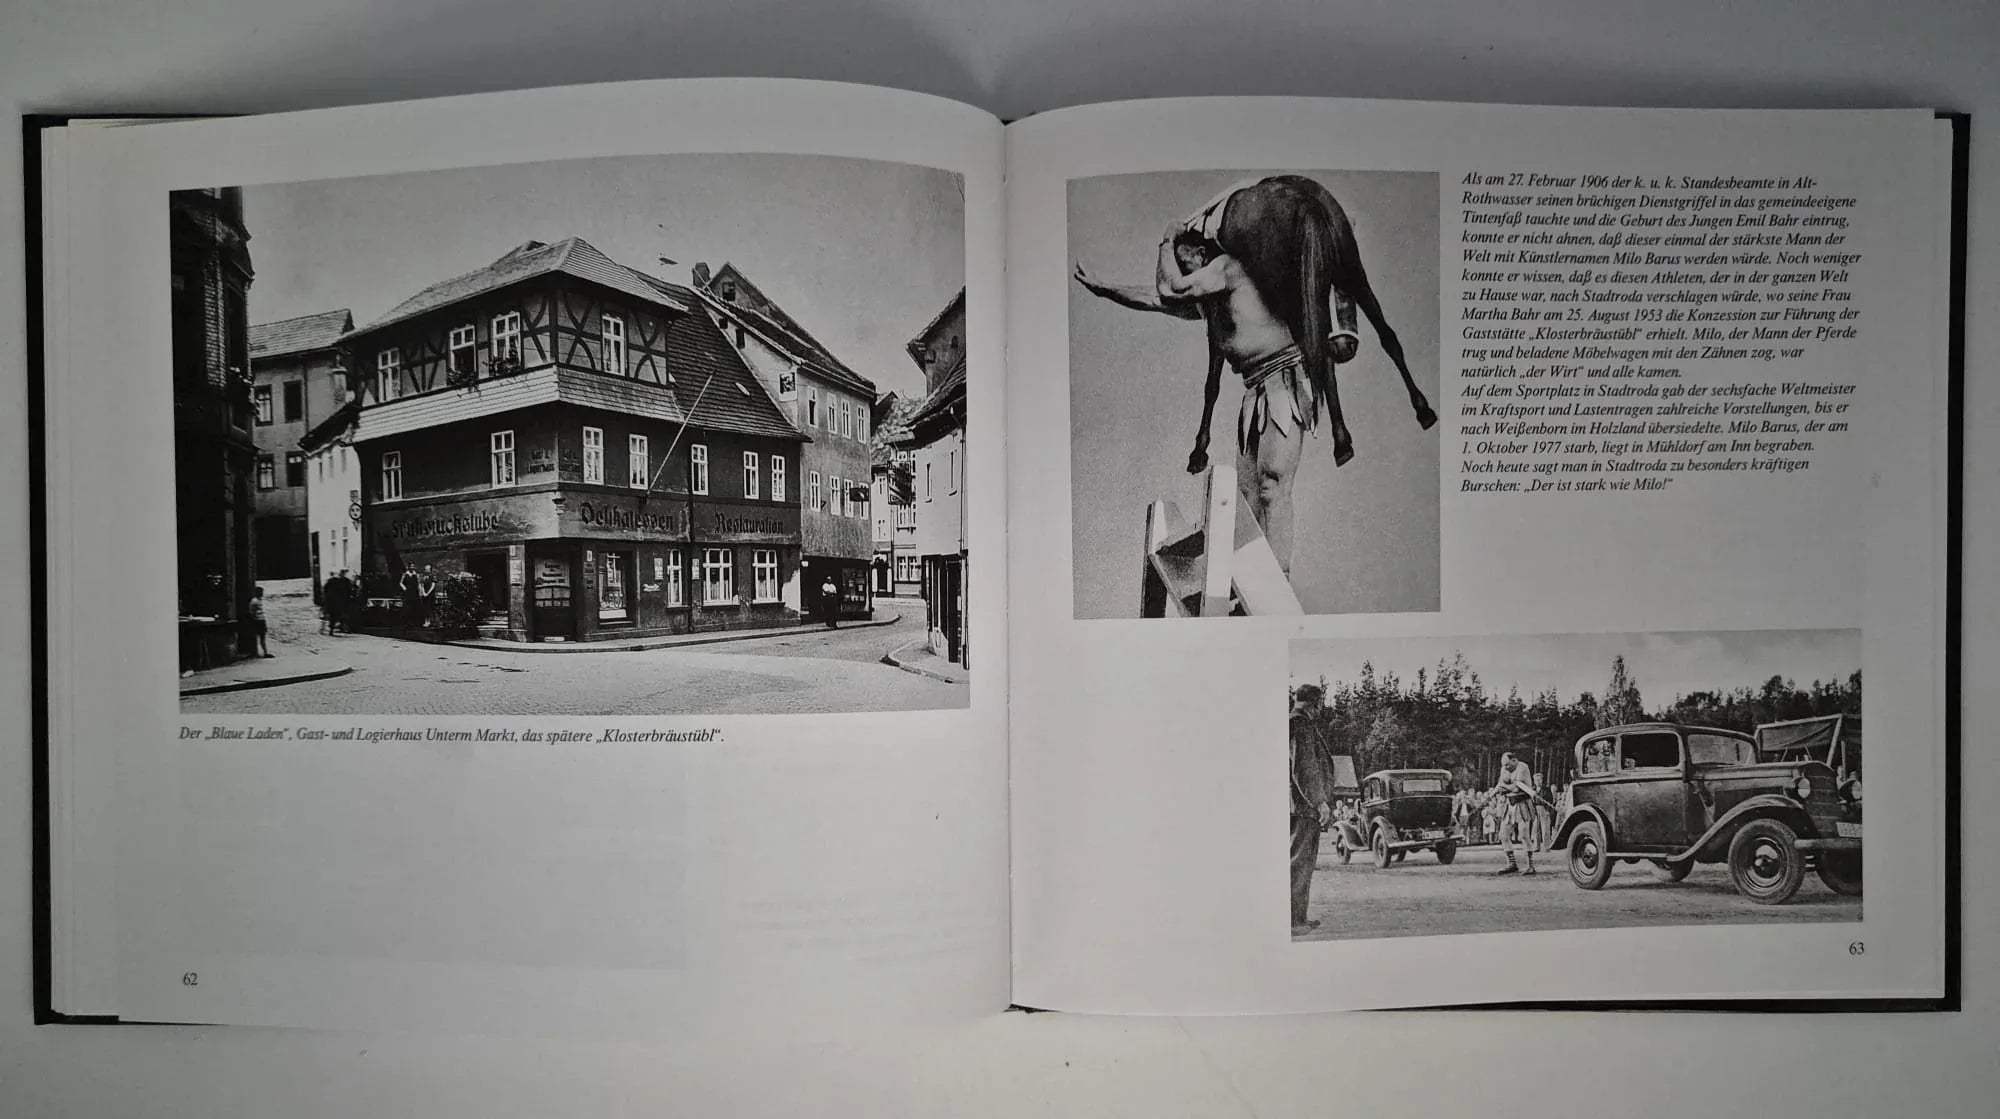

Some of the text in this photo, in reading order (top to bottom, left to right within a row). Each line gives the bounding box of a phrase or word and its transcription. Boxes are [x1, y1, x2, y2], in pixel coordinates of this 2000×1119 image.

[1462, 171, 1817, 190] Als am Februar 1906 der Standesbeamte Alt-
[1462, 191, 1857, 211] Rothwasser seinen brüchigen Dienstgriffel das gemeindeeigene
[1462, 210, 1849, 230] Tintenfaß tauchte und die Geburt des Jungen Emil Bahr eintrug,
[1461, 229, 1846, 248] konnte nicht ahnen, daß dieser einmal der stärkste Mann der
[1463, 249, 1862, 267] Welt mit Künstlernamen Milo Barus werden würde. Noch weniger
[1461, 268, 1849, 286] konnte wissen, daß diesen Athleten, der der ganzen Welt
[1479, 288, 1851, 306] Hause war, nach Stadtroda verschlagen würde, seine Frau
[1461, 307, 1861, 324] Martha Bahr am August 1953 die Konzession zur Führung der
[1462, 326, 1526, 340] Gaststätte
[1646, 327, 1687, 340] erhielt.
[1692, 327, 1725, 341] Milo,
[1728, 326, 1749, 340] der
[1752, 327, 1789, 339] Mann
[1791, 326, 1812, 339] der
[1815, 325, 1857, 342] Pferde
[1462, 345, 1805, 362] trug und beladene Möbelwagen mit den Zähnen zog, war
[1461, 364, 1516, 378] natürlich
[1587, 365, 1611, 378] und
[1612, 365, 1635, 378] alle
[1637, 365, 1682, 378] kamen.
[1461, 382, 1856, 400] Auf dem Sportplatz Stadtroda gab der sechsfache Weltmeister
[1480, 401, 1833, 419] Kraftsport und Lastentragen zahlreiche Vorstellungen, bis
[1460, 420, 1848, 438] nach Weißenborn Holzland übersiedelte. Milo Barus, der am
[1476, 438, 1814, 456] Oktober 1977 starb, liegt Mühldorf am Inn begraben.
[1461, 457, 1809, 476] Noch heute sagt man Stadtroda besonders kräftigen
[1460, 479, 1521, 492] Burschen:
[1574, 478, 1607, 492] stark
[1610, 478, 1631, 490] wie
[179, 726, 202, 739] Der
[296, 727, 330, 740] Gast-
[331, 727, 355, 740] und
[356, 727, 423, 744] Logierhaus
[426, 728, 472, 742] Unterm
[475, 728, 518, 743] Markt,
[522, 729, 544, 742] das
[545, 730, 593, 746] spätere
[1849, 941, 1865, 956] 63
[182, 971, 198, 986] 62
